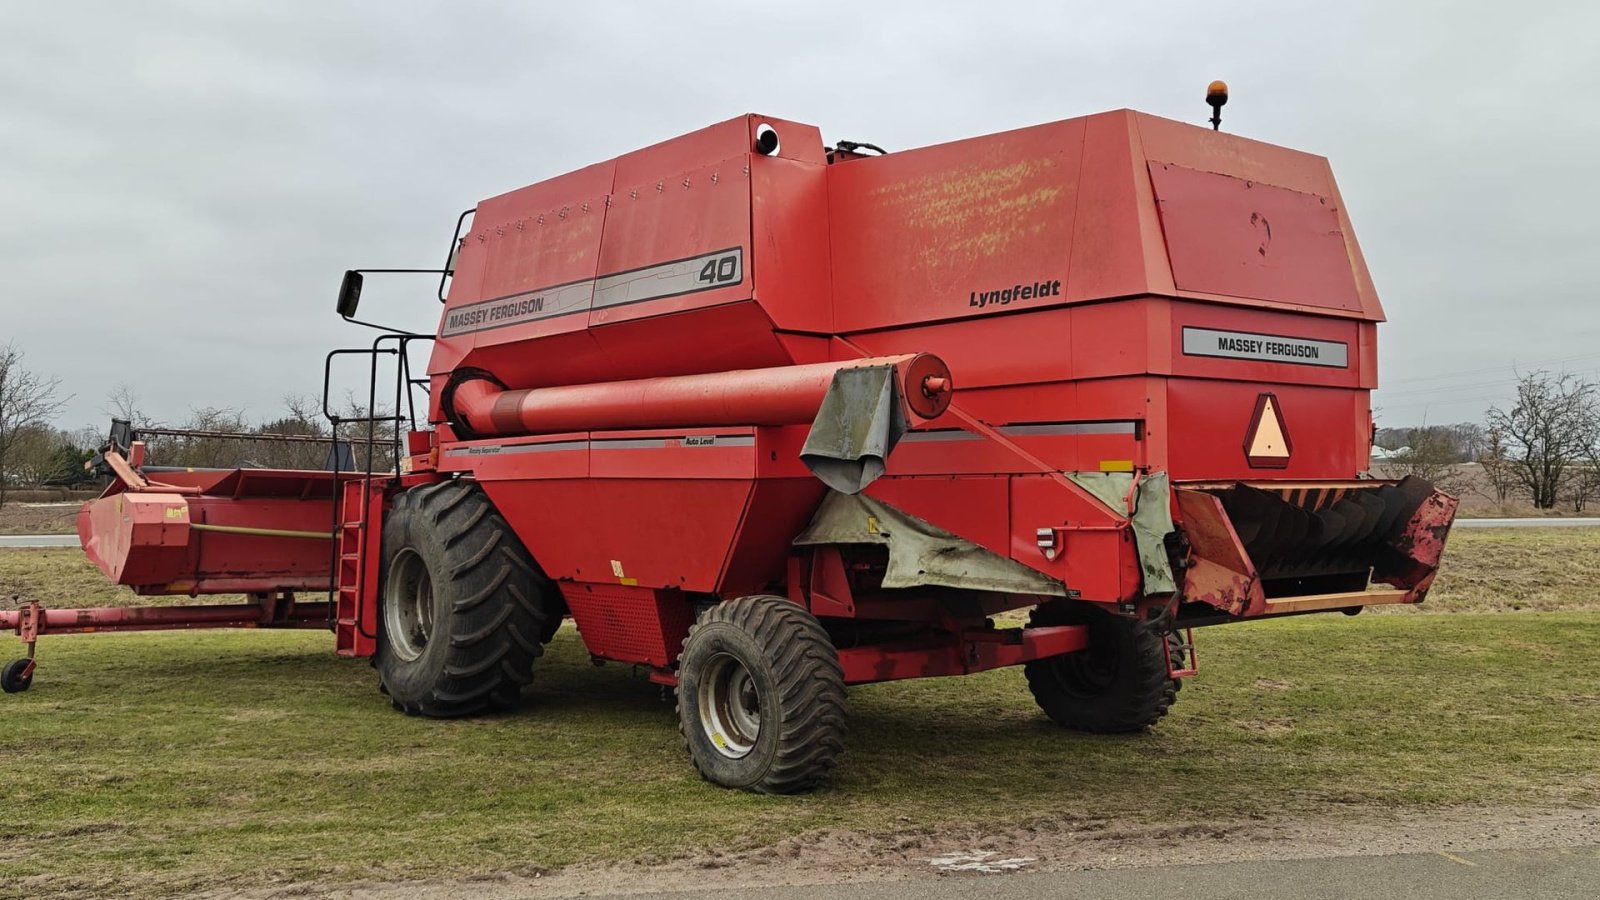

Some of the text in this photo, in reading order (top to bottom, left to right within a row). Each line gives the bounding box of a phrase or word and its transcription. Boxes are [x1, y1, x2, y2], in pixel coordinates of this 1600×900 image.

[699, 255, 737, 284] 40
[969, 280, 1060, 308] Lyngfeldt
[449, 297, 544, 329] MASSEY FERGUSON
[1218, 337, 1319, 358] MASSEY FERGUSON
[685, 437, 699, 446] Auto
[700, 436, 715, 445] Level
